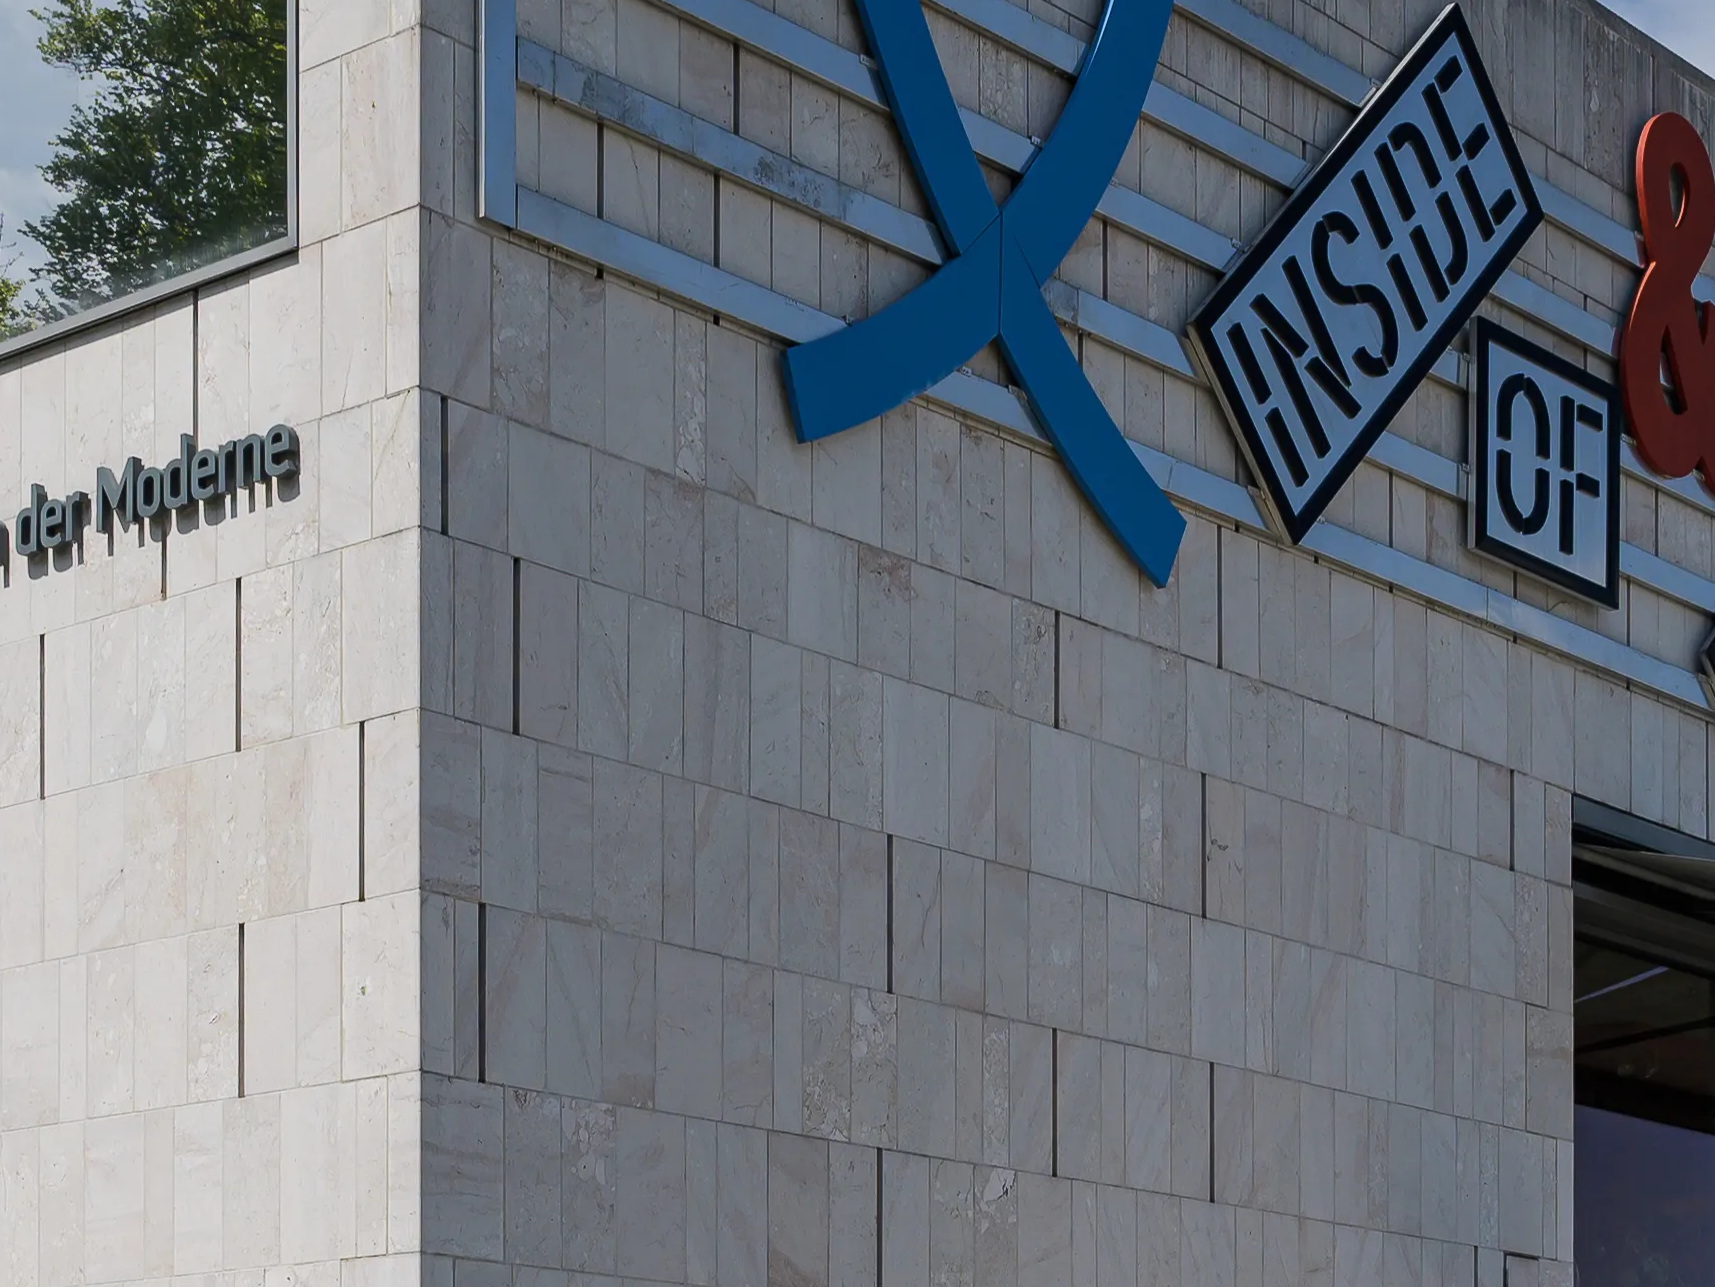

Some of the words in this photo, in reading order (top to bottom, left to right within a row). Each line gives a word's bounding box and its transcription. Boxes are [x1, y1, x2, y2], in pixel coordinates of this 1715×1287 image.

[1226, 54, 1516, 489] INSIDE
[1495, 372, 1604, 556] OF
[15, 482, 91, 556] der
[96, 421, 301, 533] Moderne
